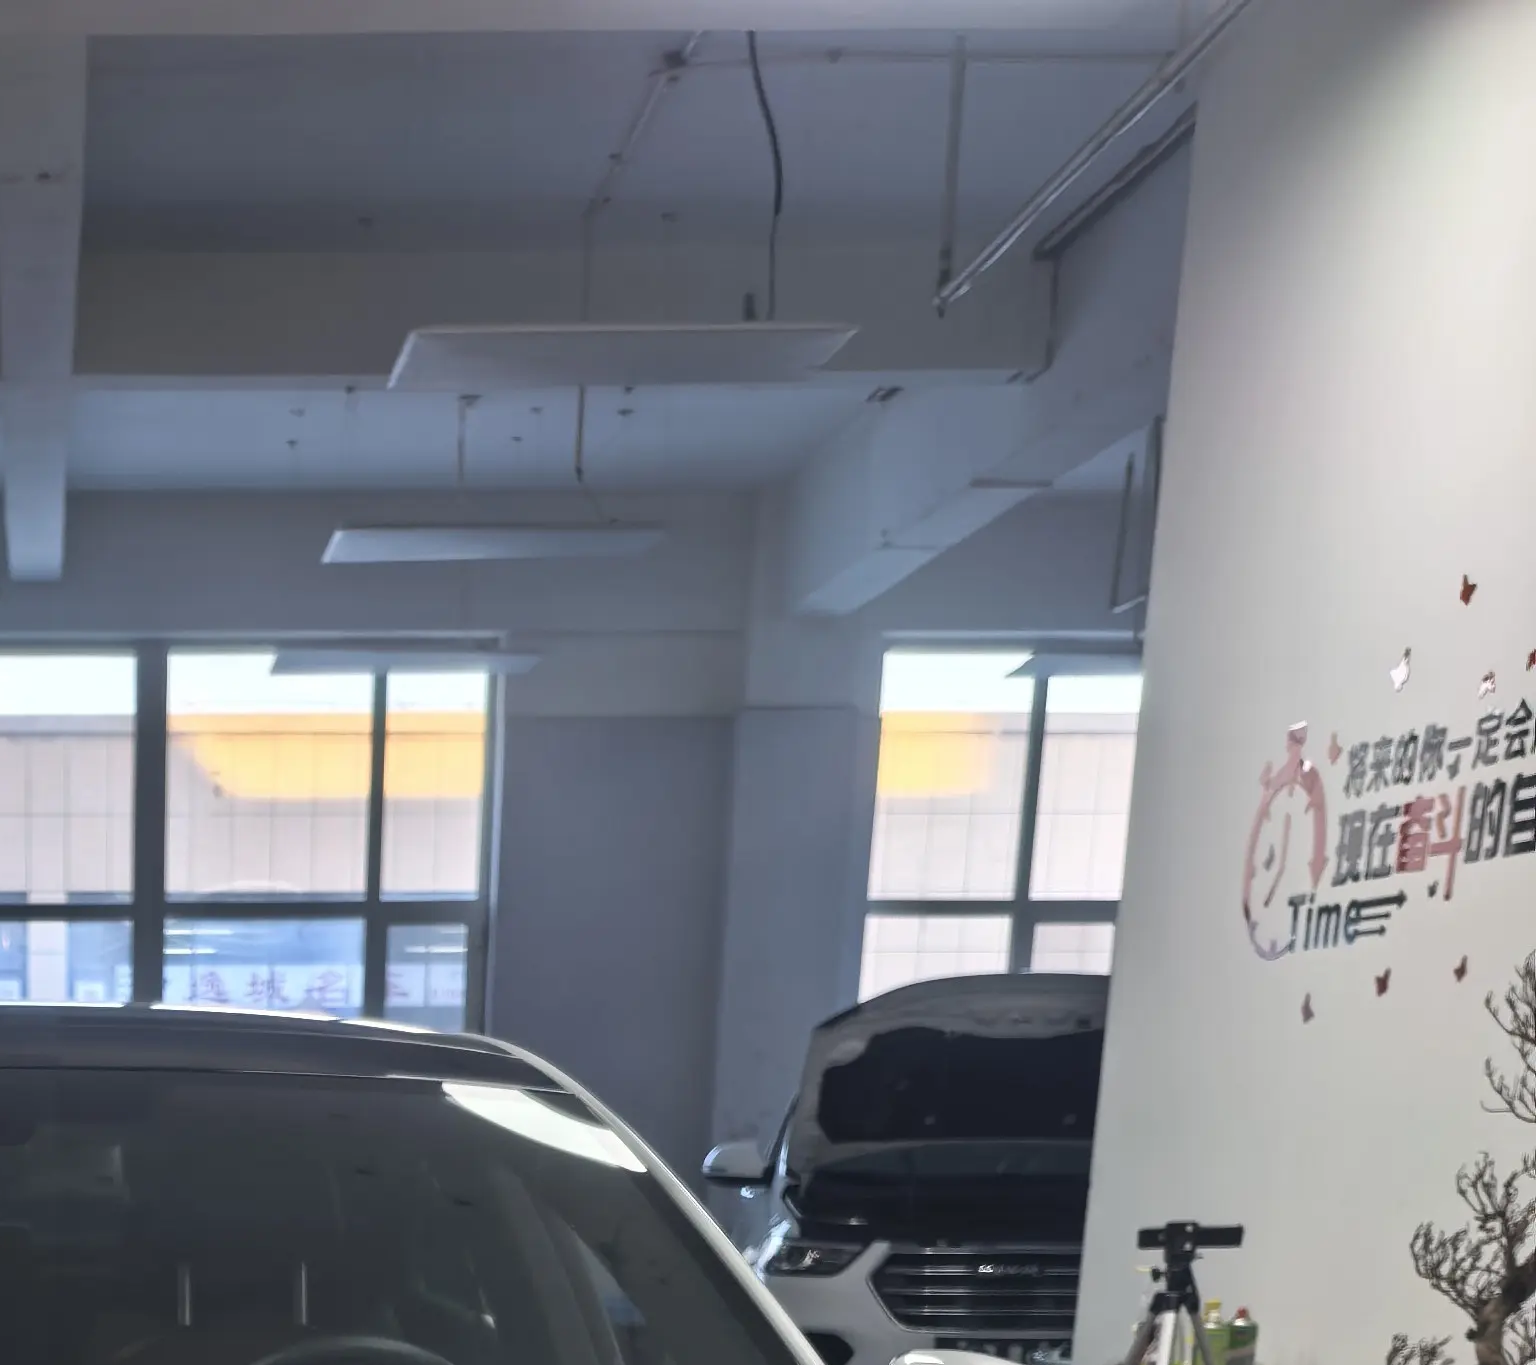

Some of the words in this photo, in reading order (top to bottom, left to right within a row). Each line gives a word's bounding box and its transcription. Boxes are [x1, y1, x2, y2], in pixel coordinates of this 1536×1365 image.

[1343, 699, 1536, 798] 将来的你一定会
[1287, 892, 1372, 953] Time
